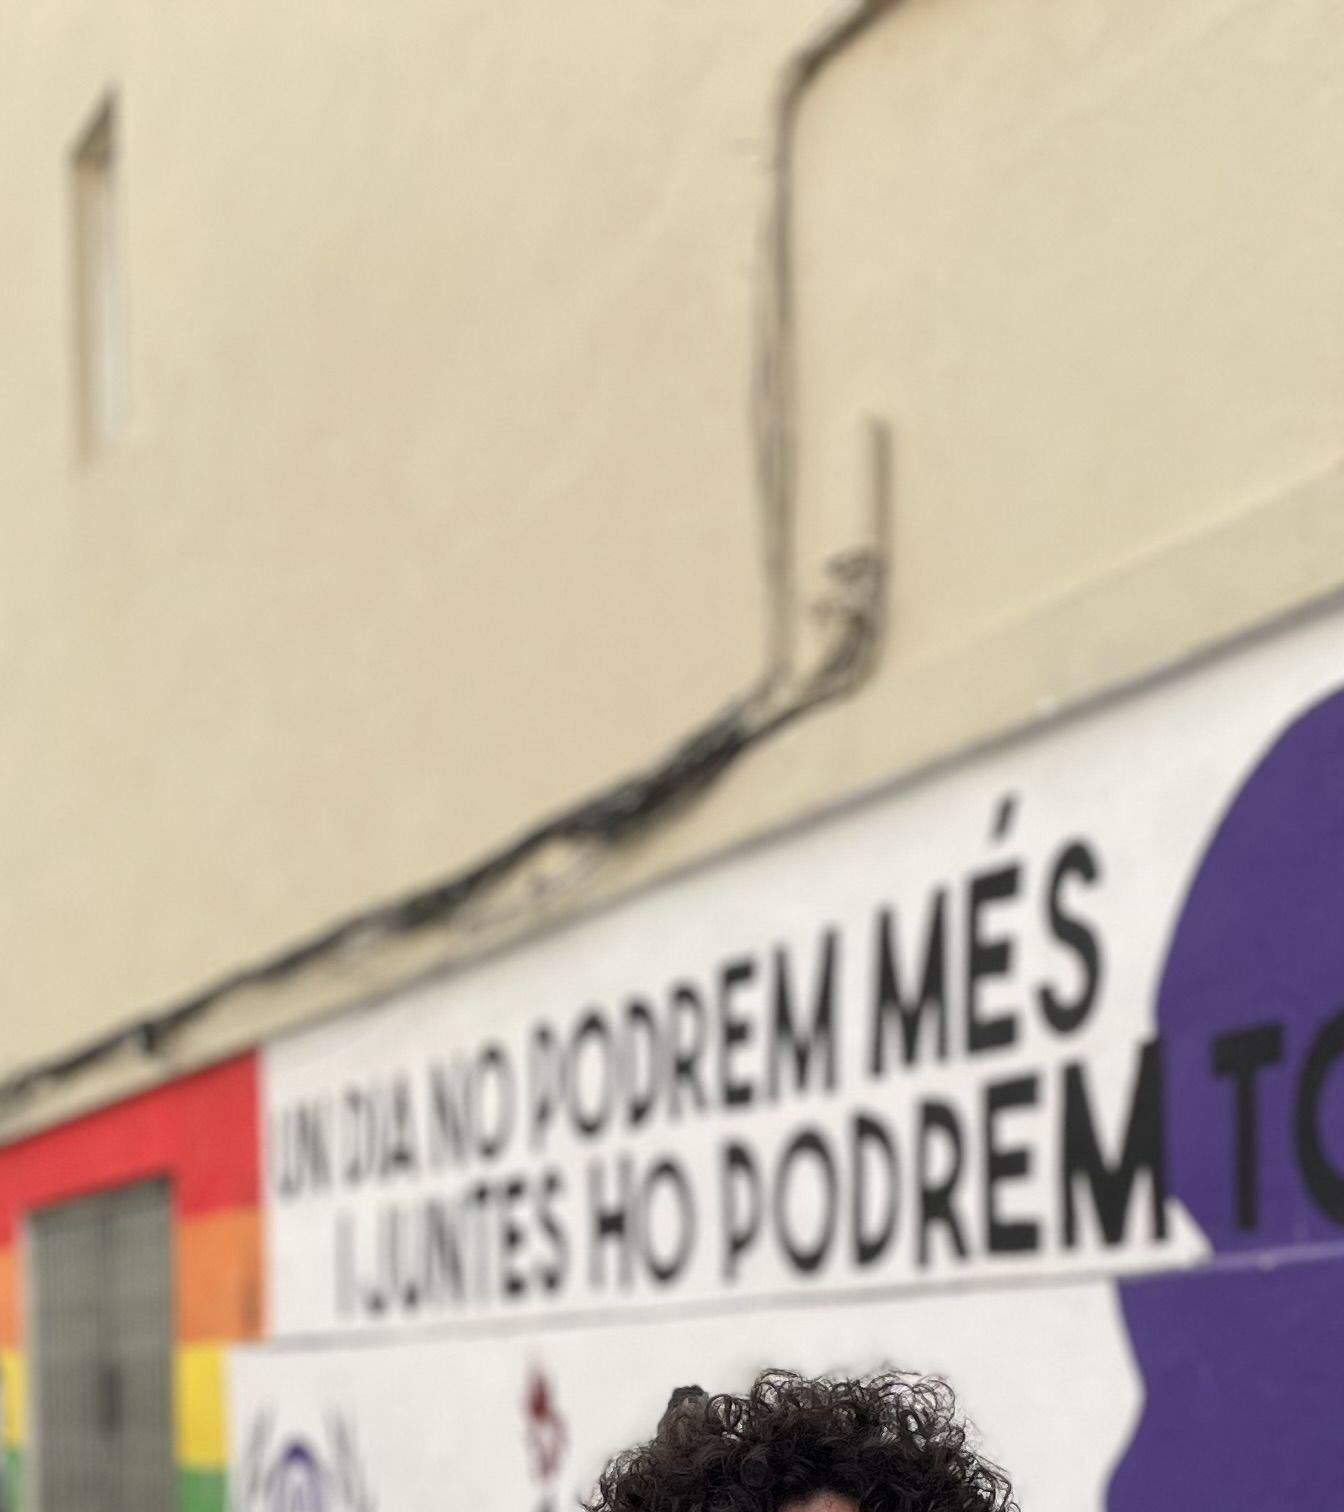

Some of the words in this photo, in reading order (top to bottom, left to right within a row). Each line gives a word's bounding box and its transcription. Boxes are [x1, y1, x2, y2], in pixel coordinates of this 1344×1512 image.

[342, 1074, 419, 1188] DIA
[428, 1042, 516, 1172] NO
[529, 926, 839, 1146] PODREM
[867, 795, 1105, 1080] MÉS
[360, 1172, 572, 1316] JUNTES
[588, 1152, 698, 1292] HO
[720, 1034, 1172, 1288] PODREM
